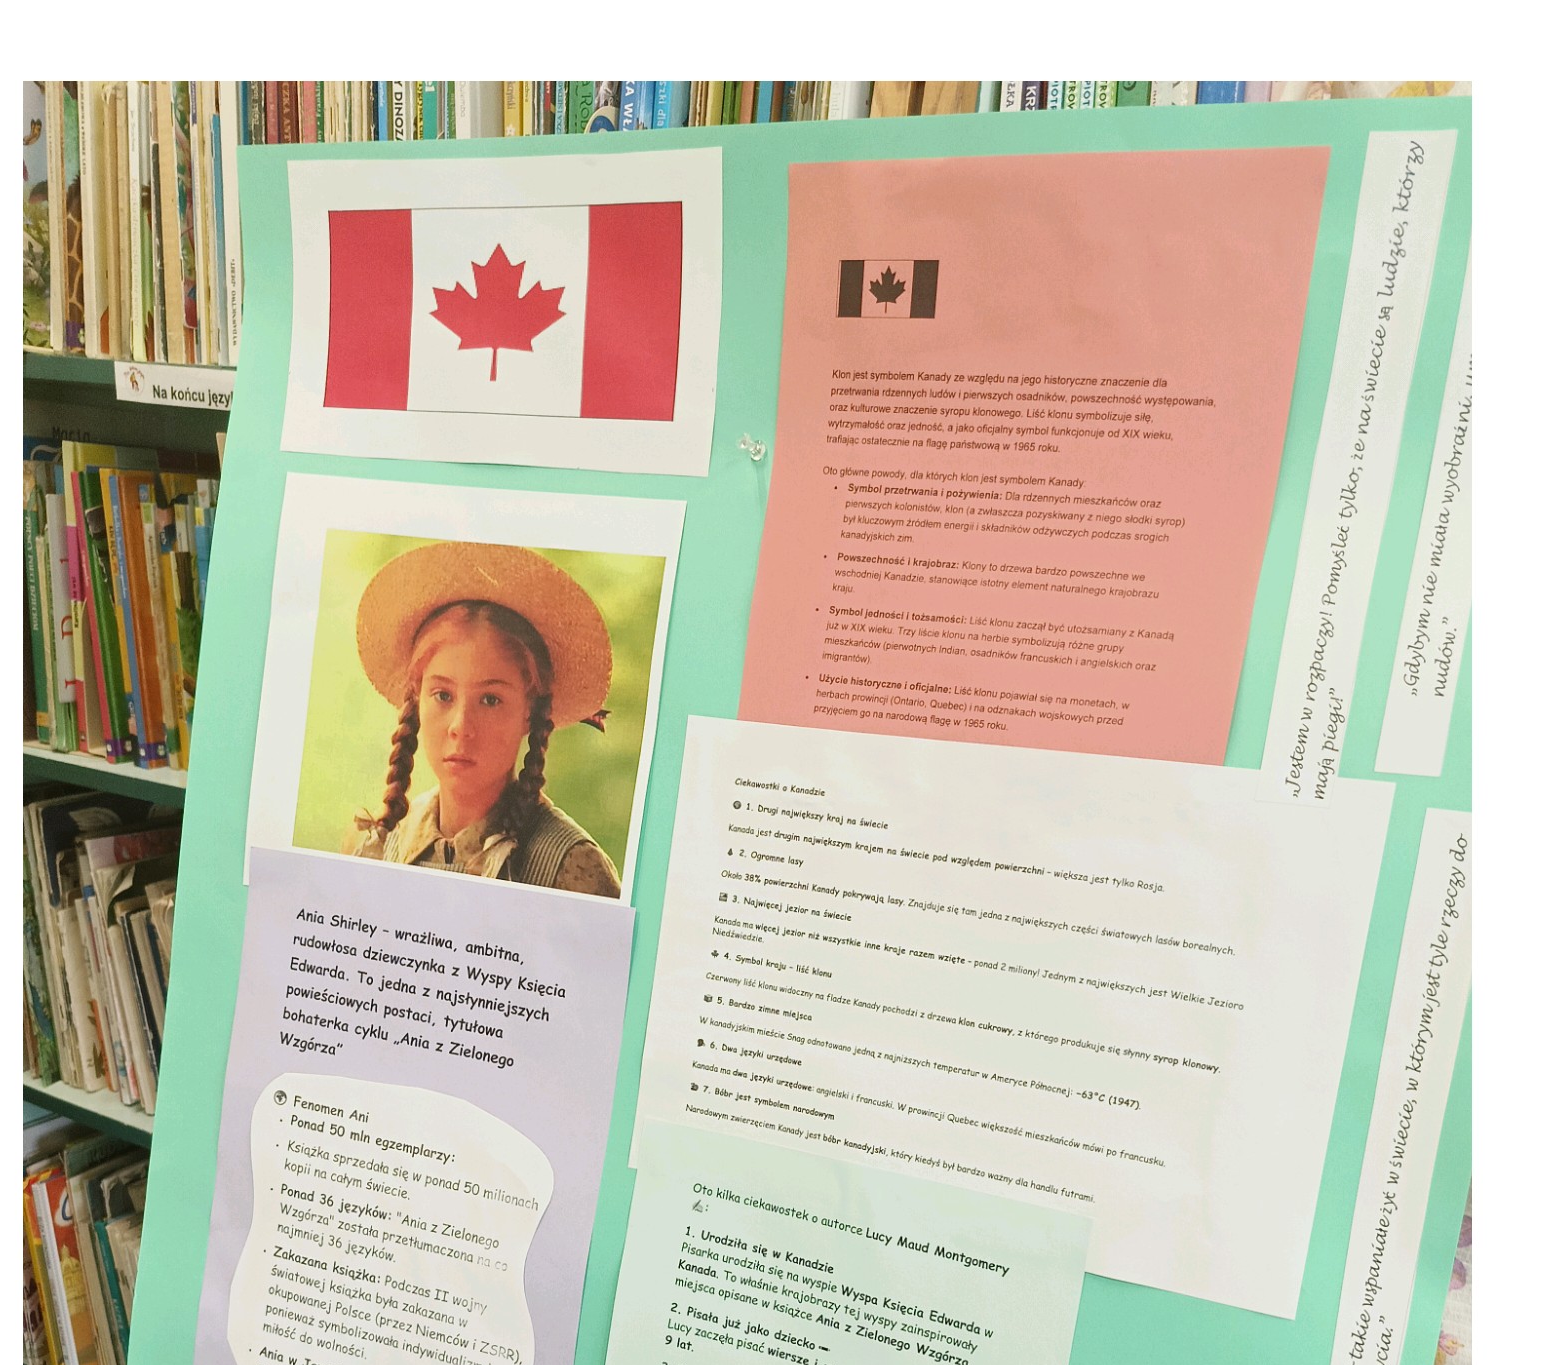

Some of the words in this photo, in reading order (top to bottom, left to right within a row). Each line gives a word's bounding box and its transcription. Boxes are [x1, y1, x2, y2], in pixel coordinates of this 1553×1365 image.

[1392, 140, 1425, 213] którzy
[1376, 221, 1408, 298] ludzie,
[1378, 305, 1394, 322] są
[1360, 323, 1387, 402] świecie
[152, 384, 168, 399] Na
[170, 385, 205, 403] końcu
[208, 389, 234, 408] języ
[1358, 402, 1374, 434] na
[1351, 440, 1366, 460] że
[1339, 465, 1364, 519] tylko,
[1430, 507, 1450, 567] miała
[1322, 525, 1350, 605] Pomyśleć
[1423, 570, 1438, 606] nie
[1306, 610, 1334, 702] rozpaczy!
[1300, 706, 1313, 720] w
[1314, 752, 1335, 801] mają
[296, 908, 325, 925] Ania
[329, 914, 378, 939] Shirley
[395, 929, 457, 953] wrażliwa,
[465, 942, 524, 966] ambitna,
[290, 956, 349, 981] Edwarda.
[358, 970, 375, 987] To
[378, 975, 417, 995] jedna
[422, 987, 431, 998] z
[436, 989, 550, 1022] najsłynniejszych
[293, 935, 357, 957] rudowłosa
[362, 945, 446, 975] dziewczynka
[451, 966, 460, 977] z
[466, 965, 513, 991] Wyspy
[517, 976, 566, 999] Księcia
[282, 1006, 349, 1033] bohaterka
[354, 1023, 389, 1041] cyklu
[435, 1042, 444, 1053] z
[448, 1041, 514, 1070] Zielonego
[285, 985, 378, 1013] powieściowych
[383, 1005, 435, 1027] postaci,
[443, 1015, 504, 1039] tytułowa
[293, 1095, 344, 1118] Fenomen
[348, 1109, 370, 1123] Ani
[290, 1114, 325, 1133] Ponad
[329, 1123, 346, 1138] 50
[349, 1130, 371, 1144] mln
[375, 1137, 456, 1165] egzemplarzy:
[685, 1225, 695, 1238] 1.
[701, 1229, 748, 1251] Urodziła
[751, 1243, 768, 1258] się
[772, 1250, 782, 1259] w
[785, 1251, 834, 1274] Kanadzie
[693, 1183, 713, 1197] Oto
[716, 1187, 741, 1204] kilka
[743, 1196, 809, 1221] ciekawostek
[811, 1215, 819, 1224] o
[820, 1217, 863, 1236] autorce
[865, 1227, 893, 1246] Lucy
[896, 1235, 930, 1254] Maud
[933, 1245, 1010, 1278] Montgomery
